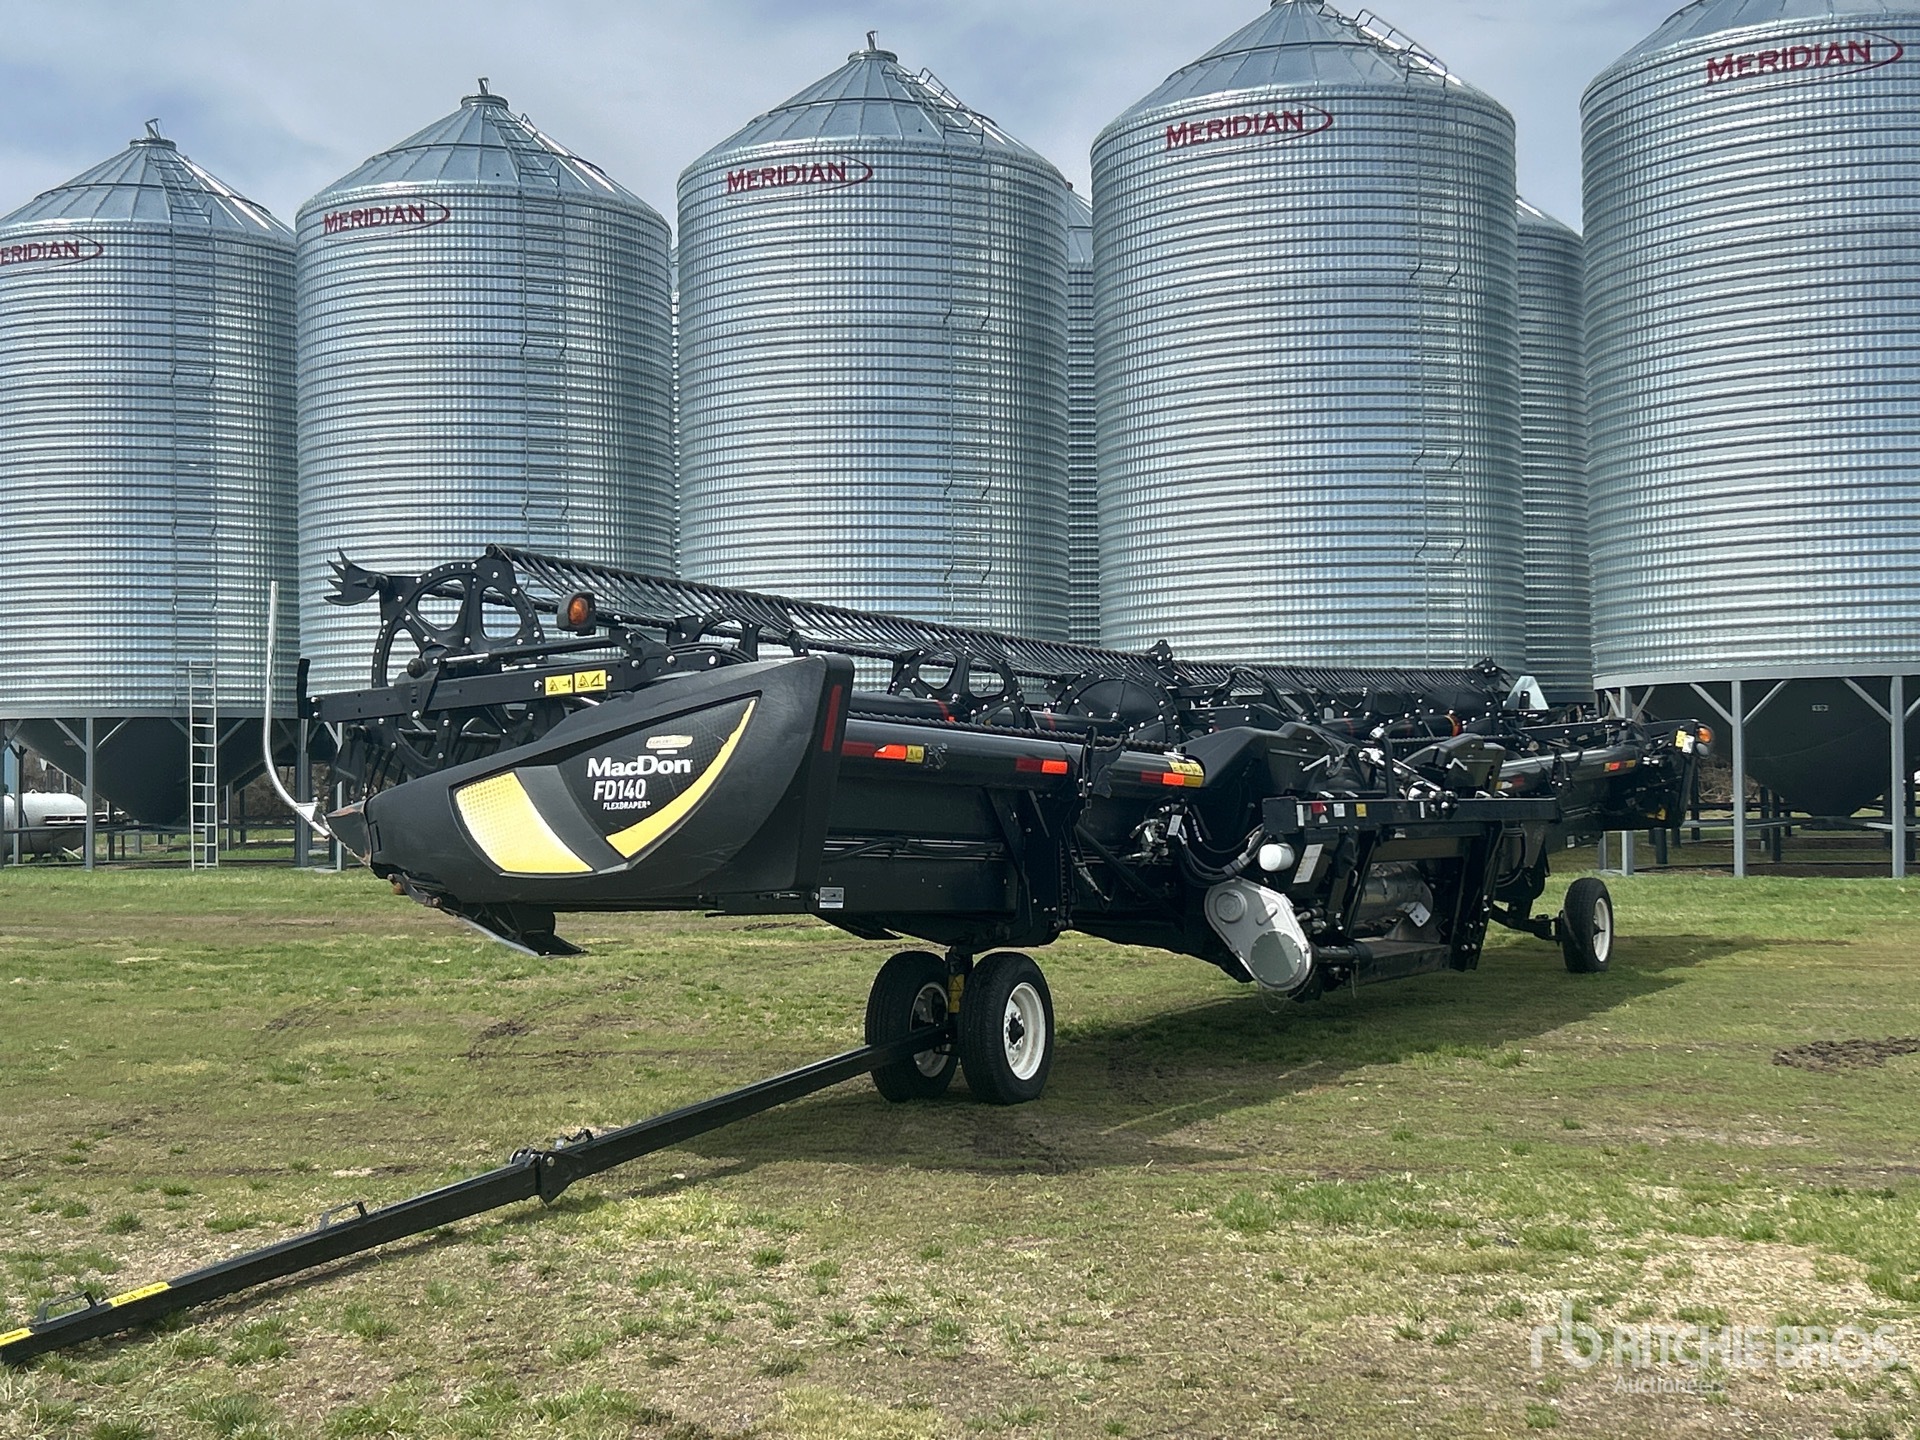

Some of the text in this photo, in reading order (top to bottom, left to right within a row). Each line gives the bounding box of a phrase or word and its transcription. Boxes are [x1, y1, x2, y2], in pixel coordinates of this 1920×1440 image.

[1706, 40, 1872, 84] MERIDIAN
[1166, 105, 1304, 150] MERIDIAN
[727, 162, 847, 195] MERIDIAN
[323, 204, 426, 235] MERIDIAN
[0, 240, 80, 266] ERIDIAN
[587, 755, 692, 777] MacDon
[593, 779, 647, 800] FD140
